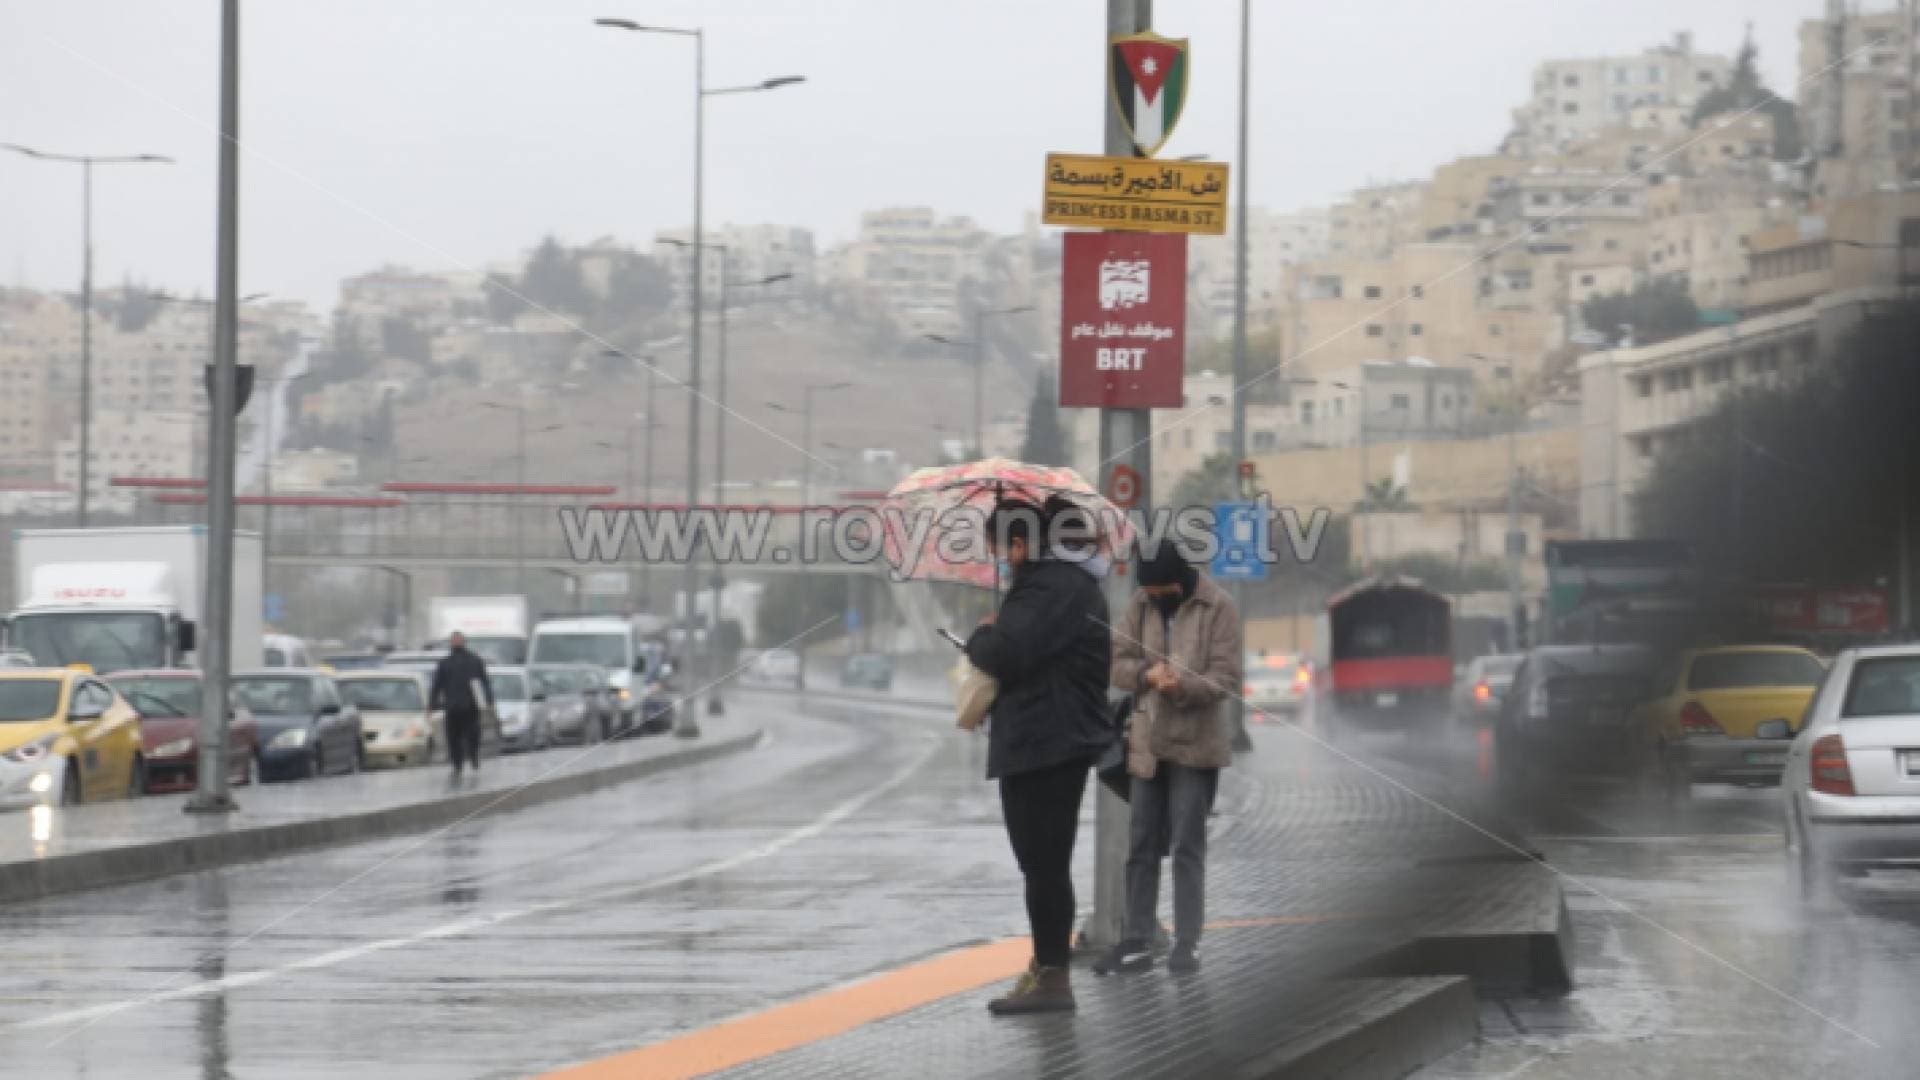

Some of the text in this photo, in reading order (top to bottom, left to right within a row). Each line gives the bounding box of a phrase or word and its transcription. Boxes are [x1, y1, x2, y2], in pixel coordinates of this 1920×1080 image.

[1050, 201, 1127, 219] PRINCESS
[1131, 206, 1189, 224] BASMA
[1071, 320, 1173, 341] موقف نقل عام
[1095, 347, 1146, 371] BRT
